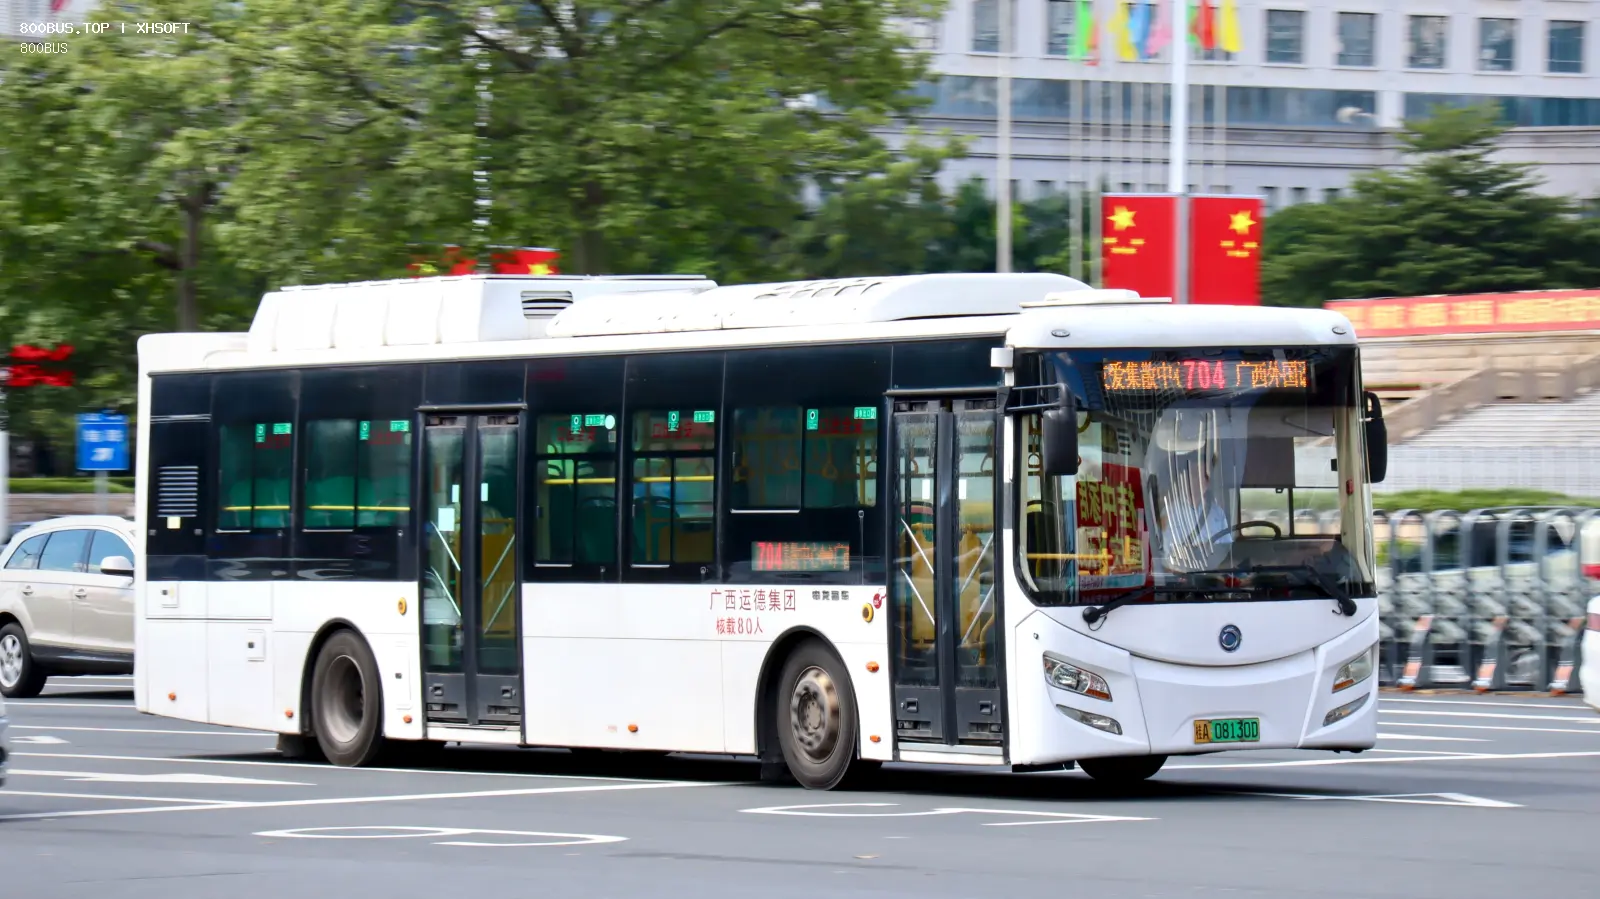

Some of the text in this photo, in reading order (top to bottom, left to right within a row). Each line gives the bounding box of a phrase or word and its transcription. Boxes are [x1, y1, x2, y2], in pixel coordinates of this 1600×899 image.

[1183, 360, 1226, 390] 704
[756, 541, 784, 570] 704
[709, 588, 796, 612] 广西运德集团
[716, 616, 764, 635] 核载80人
